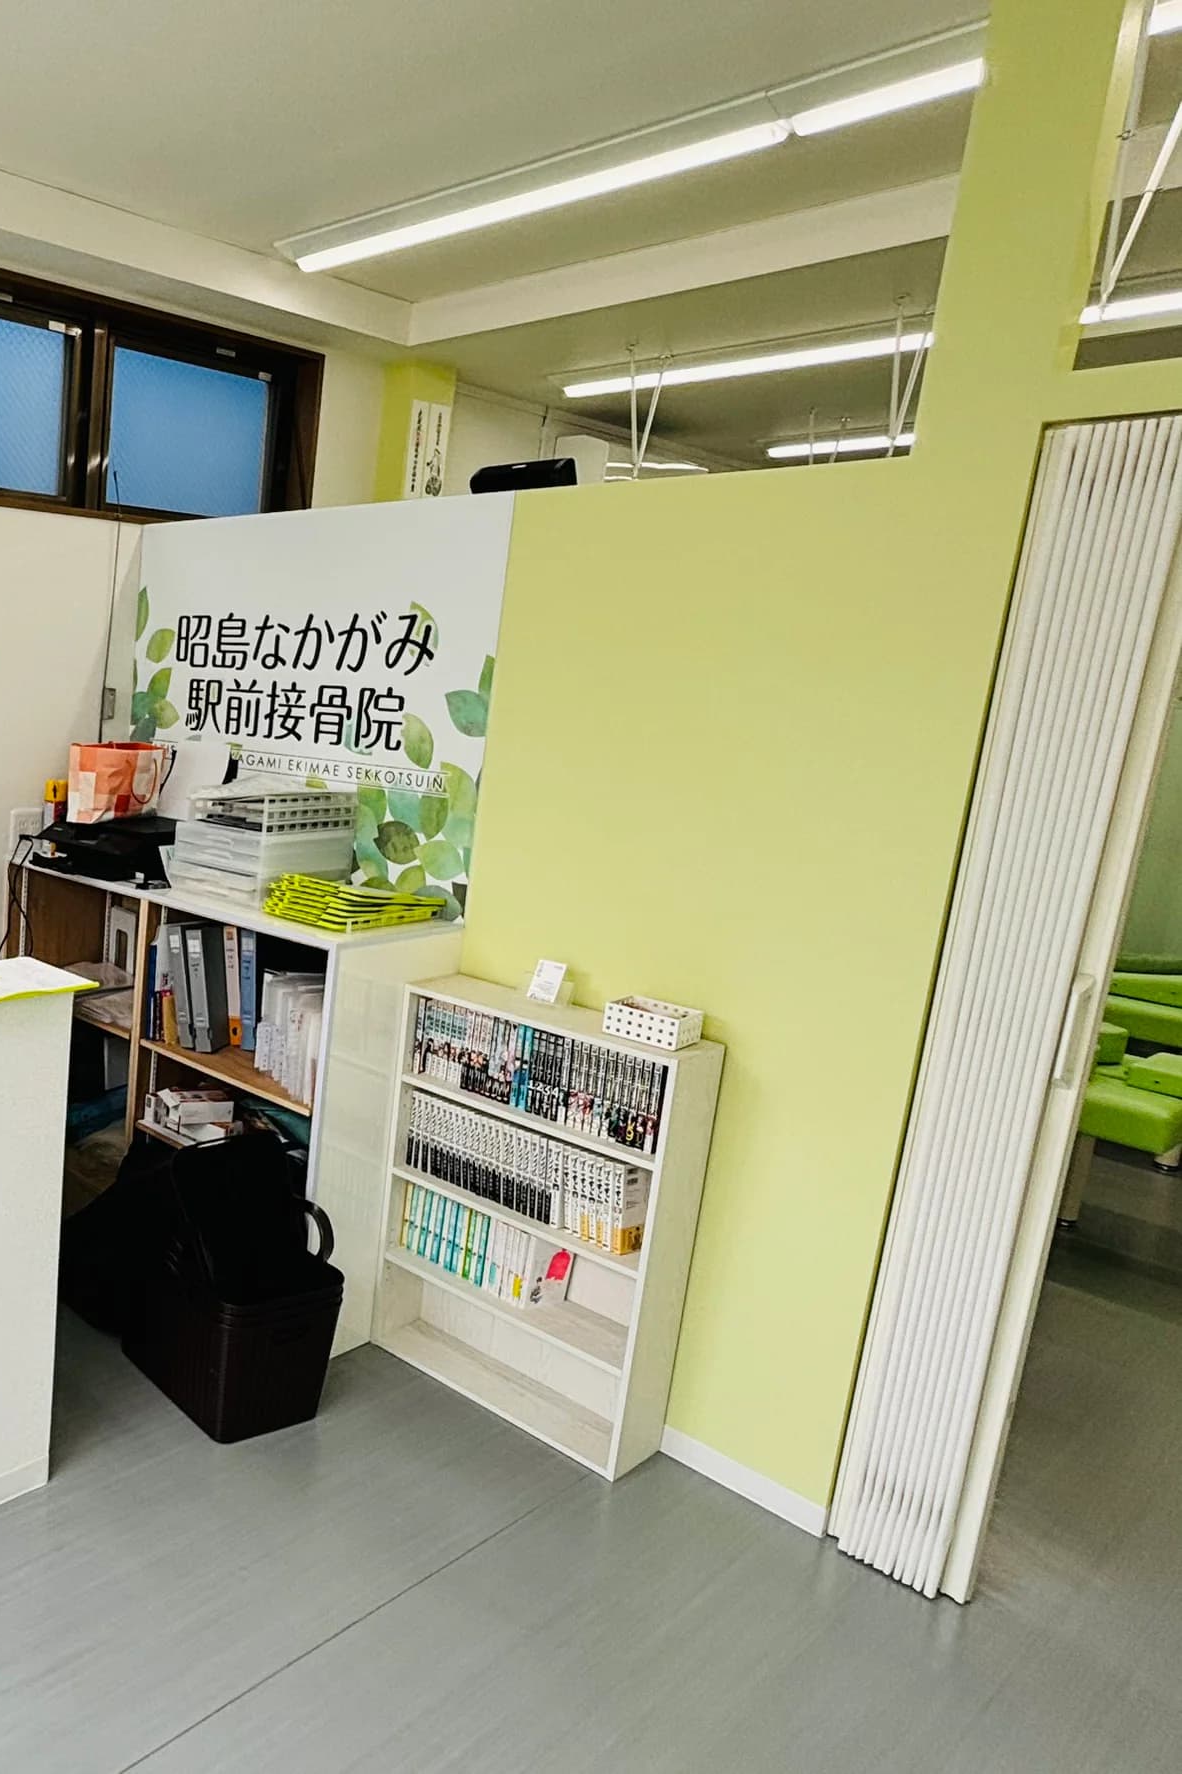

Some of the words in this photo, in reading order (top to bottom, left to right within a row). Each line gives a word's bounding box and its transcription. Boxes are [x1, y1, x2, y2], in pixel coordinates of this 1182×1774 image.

[175, 612, 435, 676] 昭島なかがみ
[185, 678, 406, 751] 駅前接骨院
[288, 759, 340, 777] EKIMAE
[346, 765, 444, 792] SEKKOTSUIN
